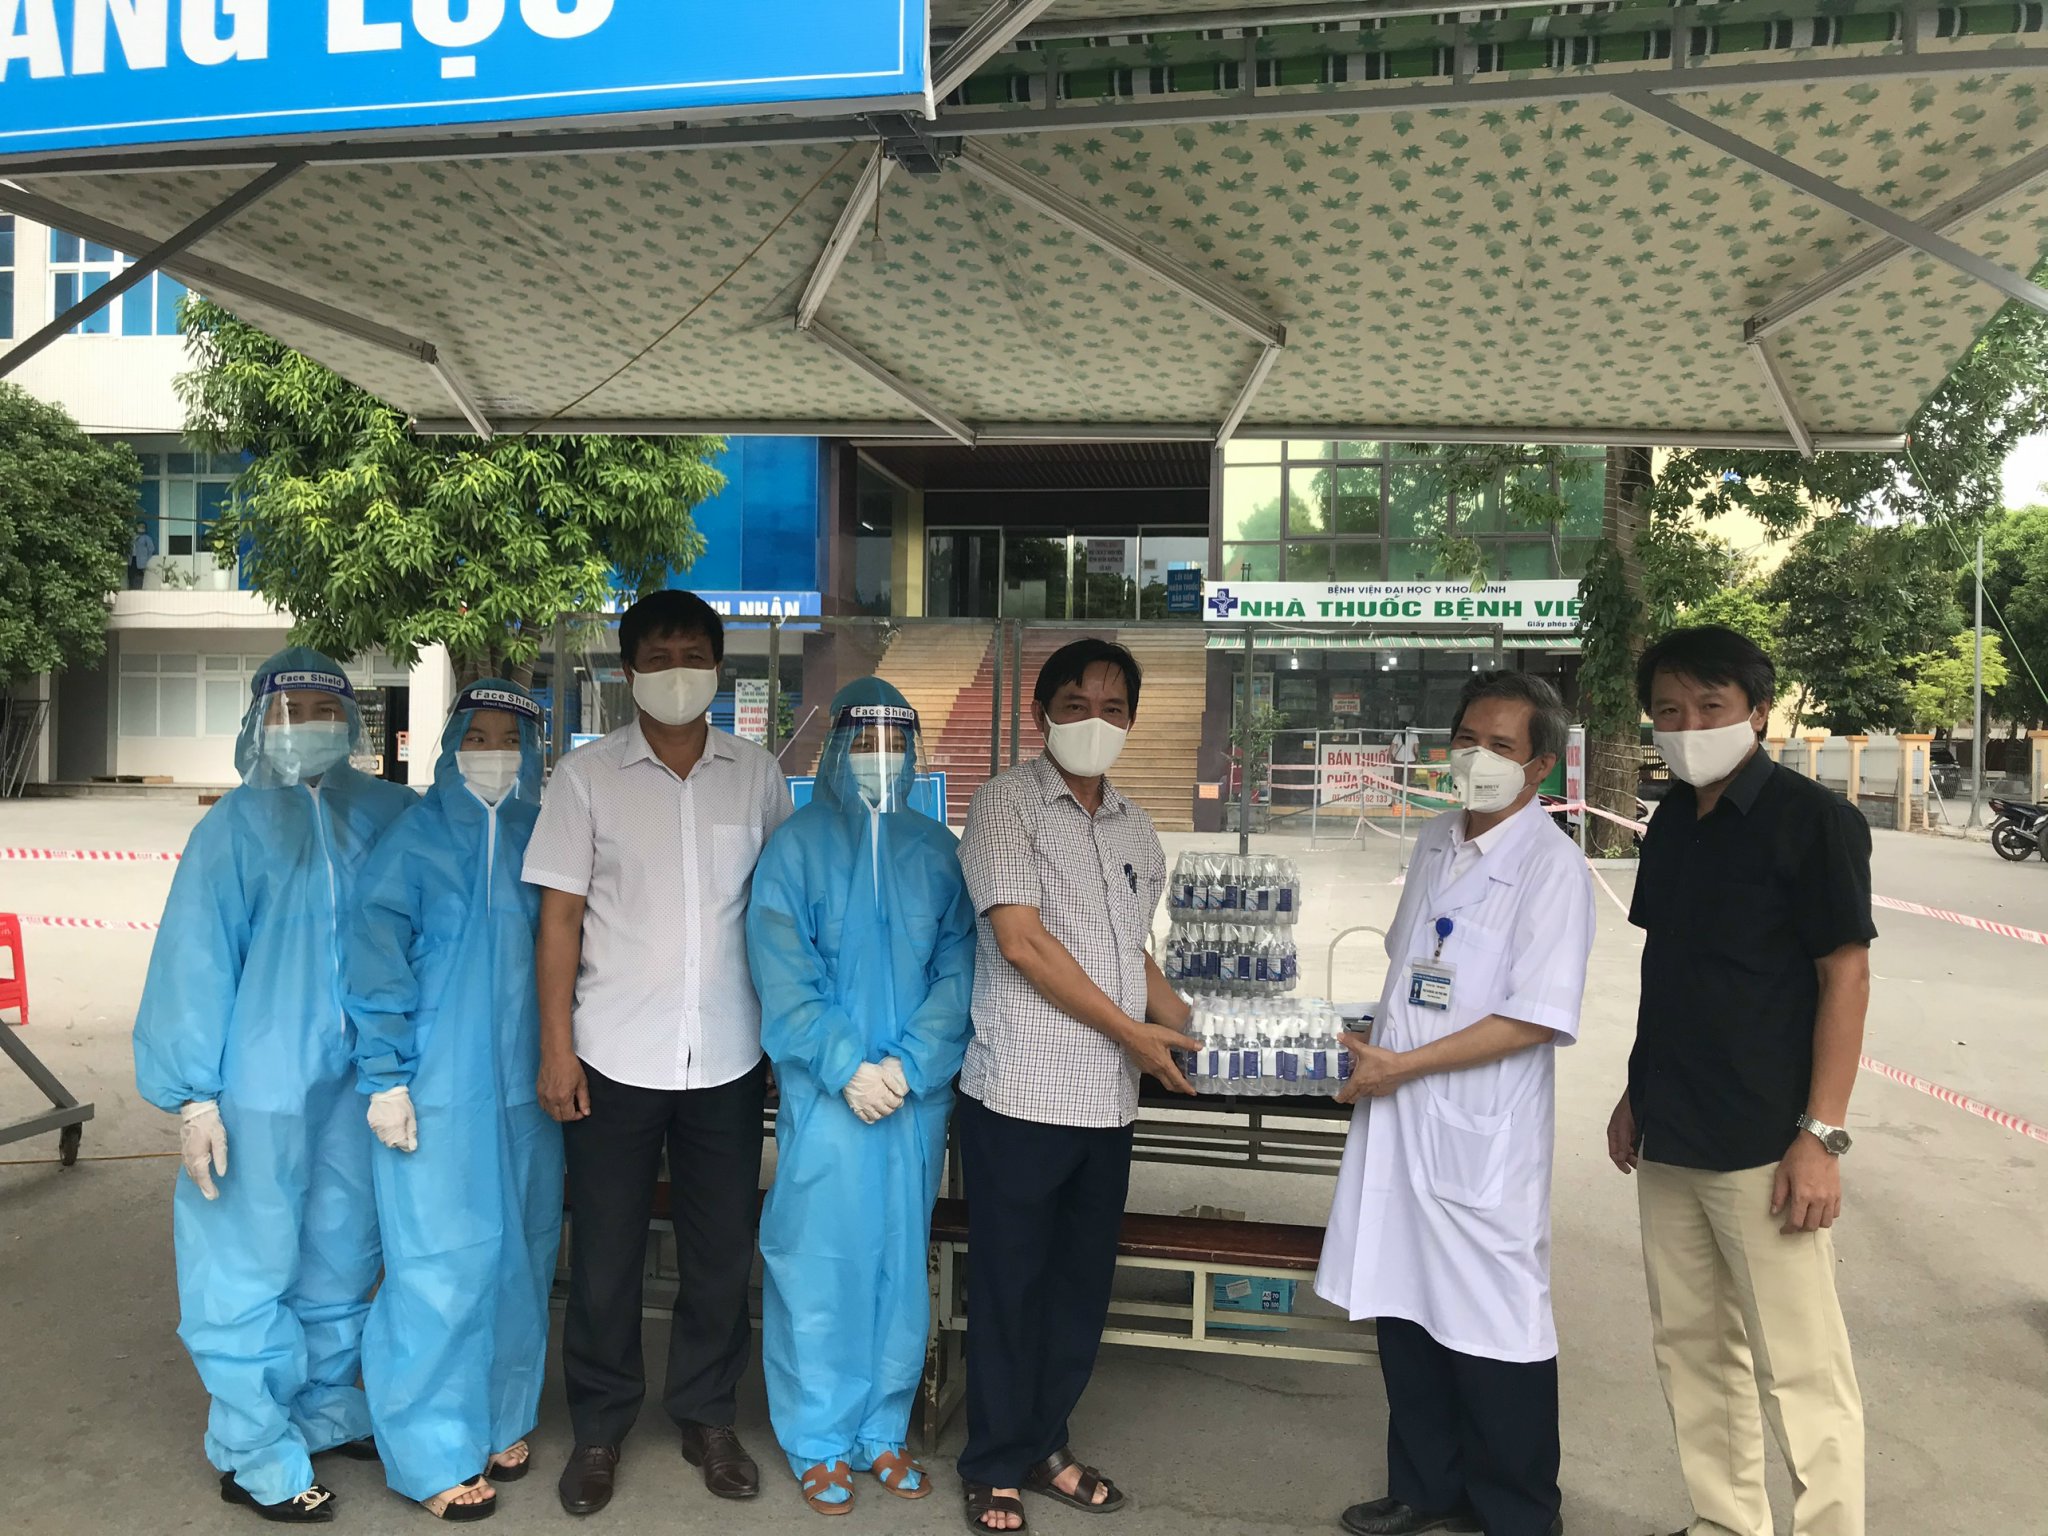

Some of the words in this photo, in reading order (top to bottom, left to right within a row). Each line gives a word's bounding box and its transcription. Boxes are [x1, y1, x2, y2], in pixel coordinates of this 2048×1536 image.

[1327, 584, 1355, 596] BỆNH
[1358, 584, 1381, 596] VIỆN
[1385, 586, 1403, 596] ĐẠI
[1407, 586, 1432, 596] HỌC
[1436, 586, 1442, 594] Y
[1445, 586, 1472, 594] KHO
[739, 596, 800, 616] NHÂN
[1240, 598, 1306, 618] NHÀ
[1317, 594, 1422, 618] THUỐC
[1434, 597, 1522, 620] BỆNH
[1534, 597, 1582, 621] VIỆ
[1527, 620, 1545, 628] Giấy
[1547, 620, 1567, 628] phép
[280, 674, 305, 682] Face
[310, 673, 342, 687] Shield
[476, 690, 505, 700] Face
[507, 693, 538, 712] Shield
[855, 707, 881, 716] Face
[884, 707, 914, 719] Shield
[1328, 749, 1352, 766] BÁN
[1376, 795, 1388, 803] 133
